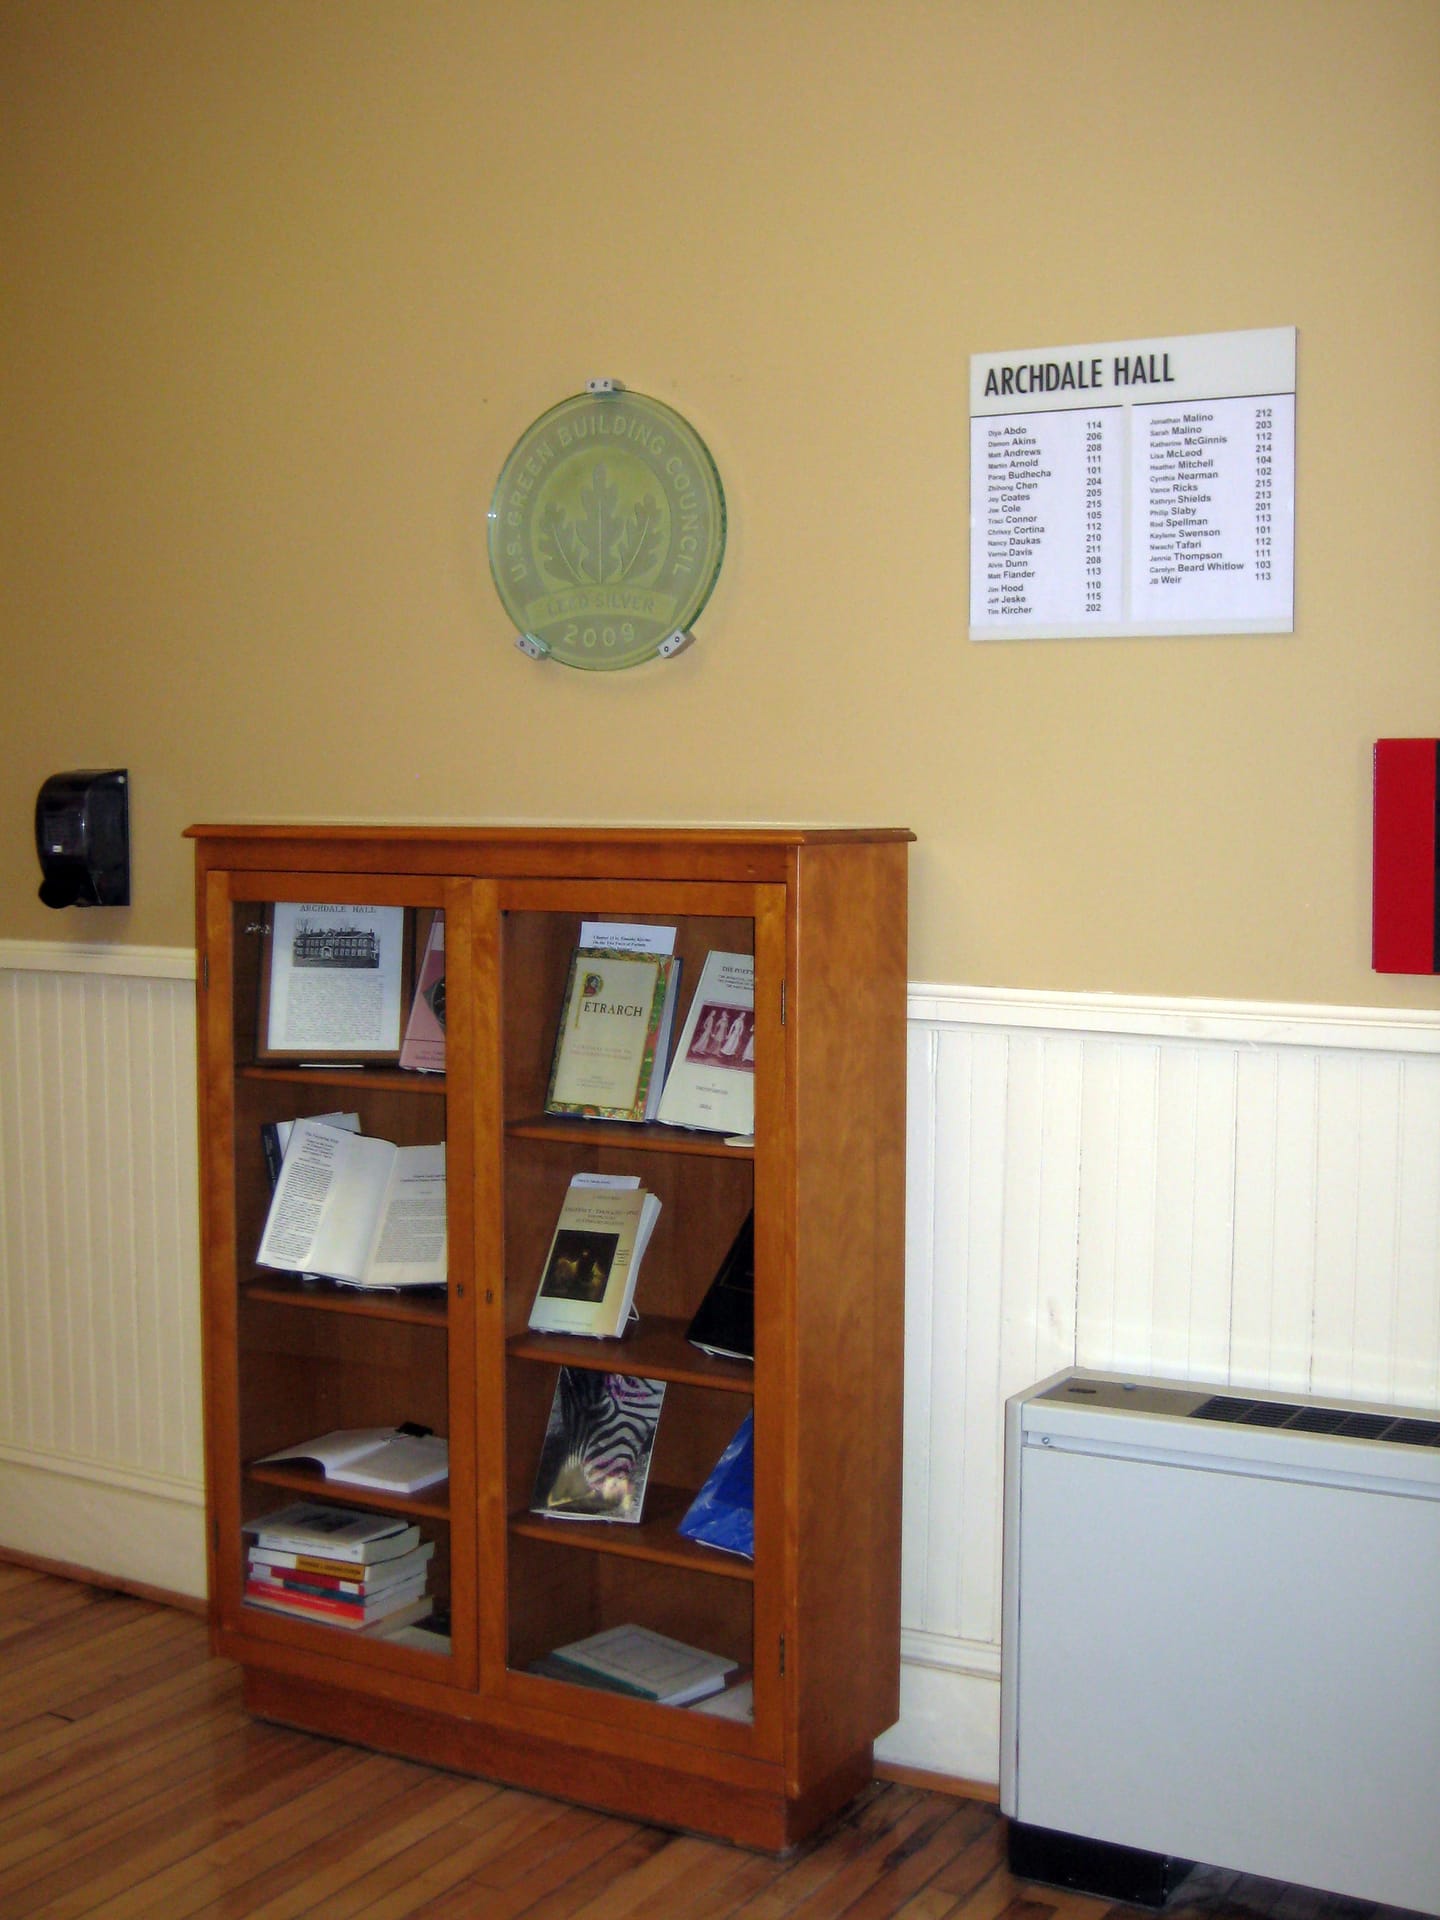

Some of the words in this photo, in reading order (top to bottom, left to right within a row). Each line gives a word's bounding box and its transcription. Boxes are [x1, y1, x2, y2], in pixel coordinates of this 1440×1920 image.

[984, 359, 1103, 397] ARCHDALE
[1114, 353, 1175, 386] HALL
[1183, 413, 1214, 422] Malino
[1256, 409, 1272, 417] 212
[1003, 426, 1027, 435] Abdo
[1087, 421, 1102, 430] 114
[1172, 426, 1202, 435] Malino
[1256, 421, 1272, 429] 203
[1012, 437, 1036, 446] Akins
[1184, 435, 1228, 446] McGinnis
[1256, 432, 1272, 440] 112
[1003, 448, 1041, 457] Andrews
[1167, 448, 1203, 458] McLeod
[1256, 444, 1272, 453] 214
[1009, 459, 1039, 468] Arnold
[1087, 455, 1102, 463] 111
[1178, 459, 1214, 469] Mitchell
[1256, 456, 1272, 464] 104
[1008, 469, 1052, 479] Budhecha
[1087, 466, 1102, 475] 101
[1178, 470, 1219, 481] Nearman
[1256, 467, 1272, 476] 102
[1015, 481, 1038, 490] Chen
[1086, 478, 1102, 486] 204
[1172, 483, 1198, 493] Ricks
[1256, 479, 1272, 487] 215
[508, 444, 555, 527] GREEN
[559, 414, 667, 455] BUILDING
[666, 456, 700, 577] COUNCIL
[1001, 492, 1031, 502] Coates
[1086, 489, 1102, 497] 205
[1178, 493, 1212, 503] Shields
[1256, 491, 1271, 499] 213
[1001, 504, 1021, 513] Cole
[1086, 500, 1102, 508] 215
[1171, 506, 1197, 516] Slaby
[1256, 503, 1271, 511] 201
[1005, 514, 1038, 524] Connor
[1087, 511, 1102, 520] 105
[1166, 517, 1208, 529] Spellman
[1256, 514, 1271, 523] 113
[1014, 525, 1045, 534] Cortina
[1178, 528, 1221, 538] Swenson
[1256, 526, 1271, 534] 101
[1009, 536, 1041, 546] Daukas
[1086, 534, 1102, 542] 210
[1176, 540, 1201, 550] Tafari
[1256, 538, 1271, 546] 112
[1009, 548, 1032, 557] Davis
[1086, 545, 1102, 553] 211
[1174, 551, 1223, 562] Thompson
[1256, 549, 1271, 558] 111
[1005, 559, 1028, 568] Dunn
[1178, 563, 1205, 572] Beard
[1207, 561, 1244, 571] Whitlow
[1256, 561, 1271, 569] 103
[1161, 575, 1182, 584] Weir
[1256, 573, 1271, 581] 113
[1001, 583, 1024, 592] Hood
[1087, 581, 1102, 589] 110
[1001, 595, 1026, 604] Jeske
[1087, 592, 1102, 600] 115
[1001, 606, 1032, 615] Kircher
[564, 622, 635, 648] 2009
[352, 905, 377, 914] HALL
